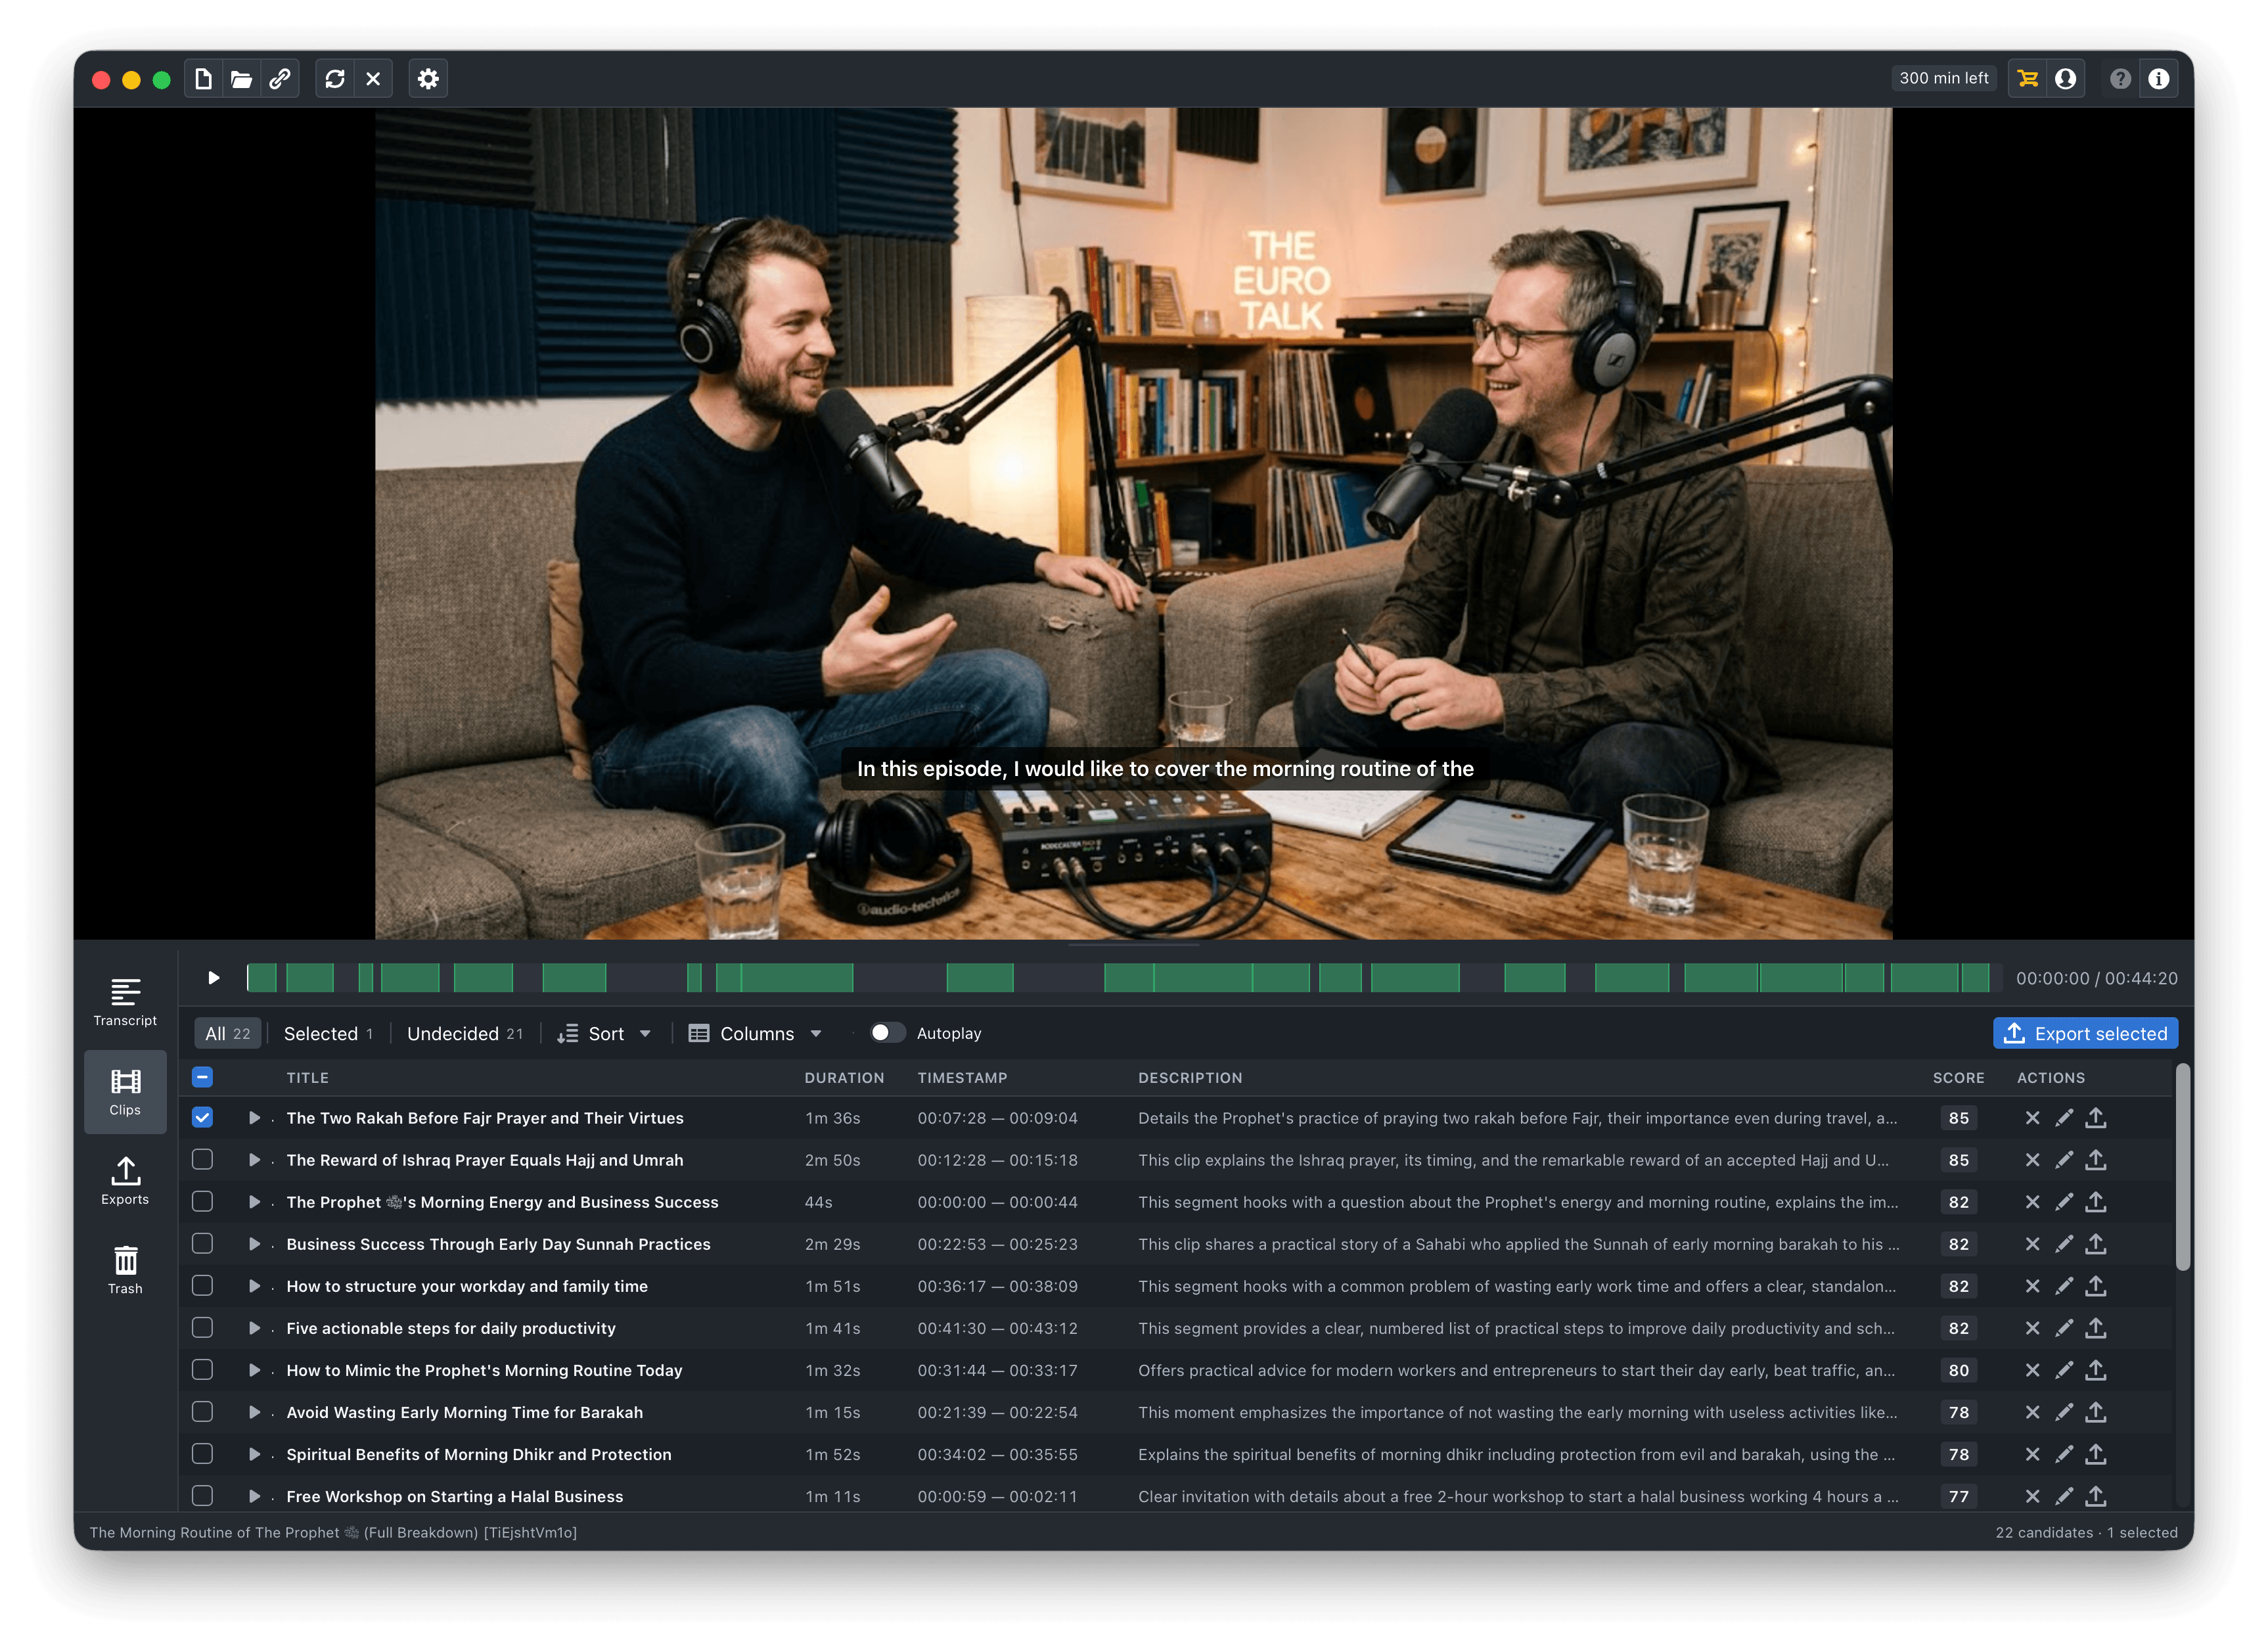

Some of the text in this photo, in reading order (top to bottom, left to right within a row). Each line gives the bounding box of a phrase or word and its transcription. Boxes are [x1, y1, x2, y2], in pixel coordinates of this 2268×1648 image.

[1900, 71, 1989, 85] 300 min left
[1247, 230, 1316, 260] THE
[1233, 265, 1332, 297] EURO
[1239, 301, 1324, 331] TALK
[2016, 971, 2090, 986] 00:00:00
[2105, 971, 2178, 986] 00:44:20
[93, 1015, 158, 1028] Transcript
[205, 1026, 250, 1041] All 22
[284, 1026, 372, 1041] Selected 1
[408, 1026, 522, 1041] Undecided 21
[589, 1026, 625, 1041] Sort
[721, 1026, 794, 1041] Columns
[917, 1026, 982, 1043] Autoplay
[2036, 1026, 2167, 1044] Export selected
[286, 1072, 329, 1084] TITLE
[805, 1072, 884, 1084] DURATION
[917, 1072, 1008, 1084] TIMESTAMP
[1139, 1072, 1242, 1084] DESCRIPTION
[1933, 1072, 1985, 1084] SCORE
[2017, 1072, 2085, 1084] ACTIONS
[109, 1104, 141, 1118] Clips
[806, 1111, 861, 1125] 1m 36s
[918, 1111, 986, 1125] 00:07:28
[1009, 1111, 1078, 1125] 00:09:04
[1949, 1111, 1970, 1125] 85
[286, 1110, 684, 1128] The Two Rakah Before Fajr Prayer and Their Virtues
[1139, 1111, 1189, 1124] Details
[1193, 1111, 1218, 1124] the
[1223, 1111, 1294, 1128] Prophet's
[1299, 1111, 1359, 1128] practice
[1364, 1111, 1379, 1124] of
[1384, 1111, 1438, 1128] praying
[1442, 1112, 1470, 1124] two
[1474, 1111, 1515, 1124] rakah
[1520, 1111, 1568, 1124] before
[1573, 1111, 1602, 1128] Fajr,
[1607, 1111, 1642, 1124] their
[1646, 1111, 1730, 1128] importance
[1735, 1114, 1769, 1124] even
[1774, 1111, 1821, 1128] during
[1826, 1111, 1871, 1128] travel,
[101, 1194, 149, 1207] Exports
[108, 1283, 143, 1294] Trash
[287, 1279, 648, 1296] How to structure your workday and family time
[806, 1280, 861, 1293] 1m 51s
[918, 1279, 986, 1293] 00:36:17
[1009, 1279, 1078, 1293] 00:38:09
[1138, 1279, 1170, 1293] This
[1174, 1281, 1238, 1296] segment
[1244, 1279, 1288, 1293] hooks
[1292, 1279, 1323, 1293] with
[1327, 1283, 1336, 1293] a
[1340, 1283, 1405, 1293] common
[1410, 1279, 1470, 1296] problem
[1475, 1279, 1490, 1293] of
[1494, 1279, 1551, 1296] wasting
[1556, 1279, 1593, 1296] early
[1597, 1279, 1633, 1293] work
[1637, 1279, 1669, 1293] time
[1673, 1279, 1701, 1293] and
[1706, 1279, 1749, 1293] offers
[1754, 1283, 1762, 1293] a
[1767, 1279, 1806, 1296] clear,
[1949, 1279, 1969, 1293] 82
[287, 1489, 624, 1506] Free Workshop on Starting a Halal Business
[806, 1490, 861, 1503] 1m 11s
[918, 1490, 986, 1503] 00:00:59
[1009, 1490, 1076, 1503] 00:02:11
[1139, 1490, 1178, 1503] Clear
[1182, 1490, 1250, 1503] invitation
[1254, 1490, 1285, 1503] with
[1290, 1490, 1339, 1503] details
[1343, 1490, 1386, 1503] about
[1390, 1493, 1399, 1503] a
[1403, 1490, 1433, 1503] free
[1438, 1490, 1489, 1503] 2-hour
[1492, 1490, 1564, 1506] workshop
[1568, 1491, 1584, 1503] to
[1589, 1491, 1623, 1503] start
[1627, 1493, 1635, 1503] a
[1641, 1490, 1675, 1503] halal
[1680, 1490, 1745, 1503] business
[1750, 1490, 1807, 1506] working
[1813, 1490, 1823, 1503] 4
[1827, 1490, 1869, 1503] hours
[1873, 1493, 1882, 1503] a
[1949, 1490, 1969, 1503] 77
[89, 1526, 116, 1538] The
[120, 1526, 175, 1541] Morning
[181, 1526, 233, 1538] Routine
[237, 1526, 251, 1538] of
[255, 1526, 281, 1538] The
[286, 1526, 340, 1541] Prophet
[364, 1526, 393, 1541] (Full
[397, 1526, 478, 1541] Breakdown)
[484, 1526, 577, 1541] [TiEjshtVm1o]
[1996, 1526, 2013, 1538] 22
[2018, 1526, 2094, 1538] candidates
[2107, 1526, 2113, 1538] 1
[2120, 1526, 2178, 1538] selected
